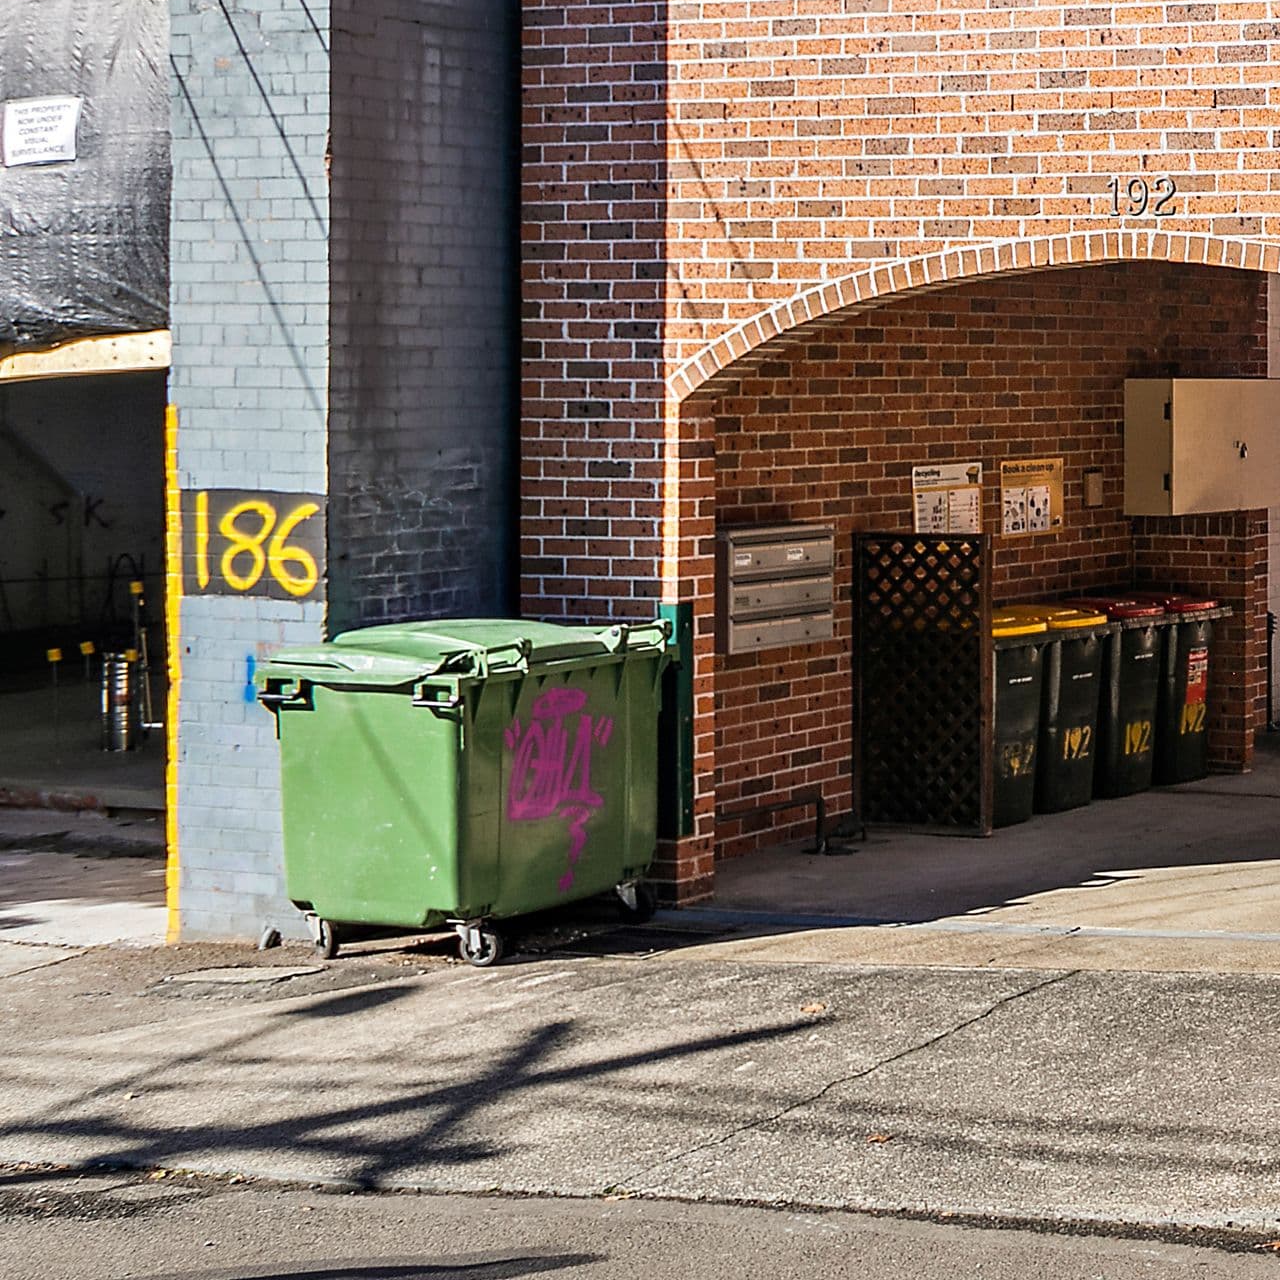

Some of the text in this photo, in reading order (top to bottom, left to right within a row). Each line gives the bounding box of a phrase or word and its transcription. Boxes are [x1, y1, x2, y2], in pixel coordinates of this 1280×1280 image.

[31, 104, 71, 113] PROPERTY
[19, 125, 58, 135] CONSTANT
[1107, 177, 1177, 217] 192
[914, 469, 940, 478] Recycling
[1002, 463, 1020, 473] Book
[1026, 464, 1045, 472] clean
[1046, 463, 1054, 472] up
[196, 491, 320, 596] 186
[1181, 703, 1207, 735] 192
[1064, 725, 1091, 760] 192
[1125, 720, 1151, 755] 192
